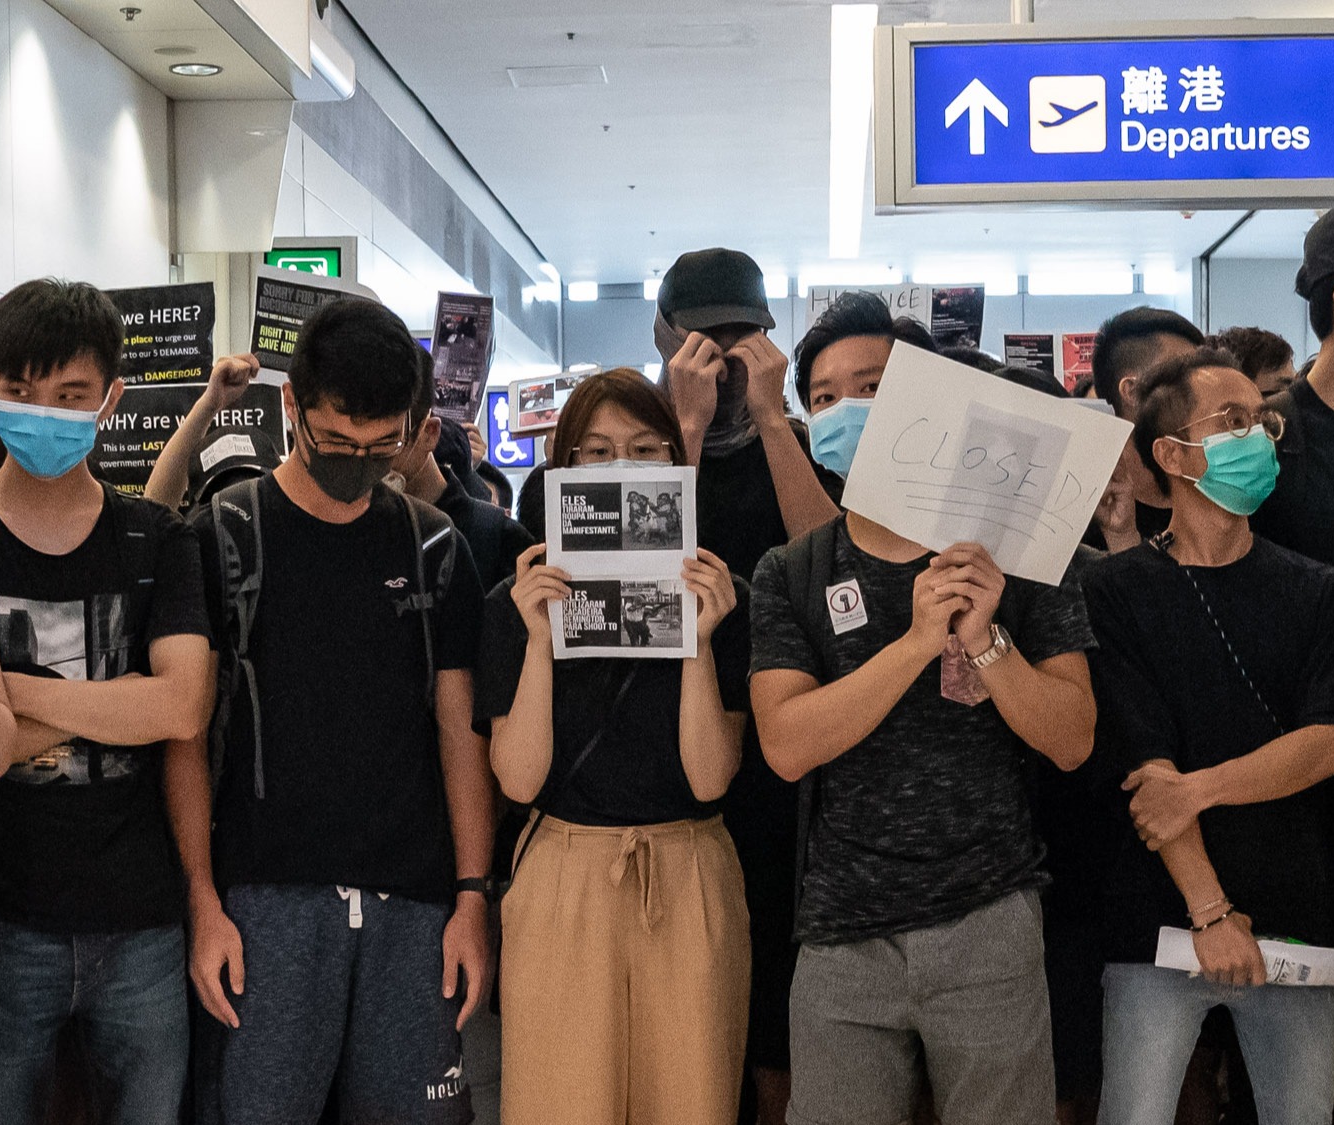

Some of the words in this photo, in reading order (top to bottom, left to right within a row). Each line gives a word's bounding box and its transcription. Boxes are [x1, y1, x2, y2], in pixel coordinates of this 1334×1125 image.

[1120, 65, 1226, 115] 離港
[1120, 120, 1311, 159] Departures
[296, 288, 315, 305] FOR
[121, 313, 145, 326] we
[149, 305, 202, 325] HERE?
[259, 325, 284, 339] RIGHT
[130, 335, 154, 346] place
[155, 335, 164, 343] to
[164, 335, 182, 345] urge
[183, 333, 197, 342] our
[258, 337, 280, 352] SAVE
[128, 350, 138, 359] to
[138, 350, 152, 358] our
[153, 349, 159, 357] 5
[159, 347, 201, 357] DEMANDS.
[137, 374, 144, 382] is
[144, 368, 202, 382] DANGEROUS
[99, 413, 138, 431] WHY
[142, 415, 171, 429] are
[102, 443, 118, 453] This
[119, 443, 126, 452] is
[126, 444, 142, 452] our
[142, 441, 165, 451] LAST
[99, 459, 146, 470] government
[562, 495, 587, 506] ELES
[562, 505, 595, 513] TIRARAM
[562, 512, 586, 520] ROUPA
[586, 512, 620, 520] INTERIOR
[563, 520, 573, 528] DA
[562, 526, 619, 535] MANIFESTANTE.
[563, 600, 606, 609] UTILIZARAM
[564, 622, 583, 631] PARA
[583, 622, 607, 630] SHOOT
[608, 622, 618, 630] TO
[565, 630, 582, 639] KILL.
